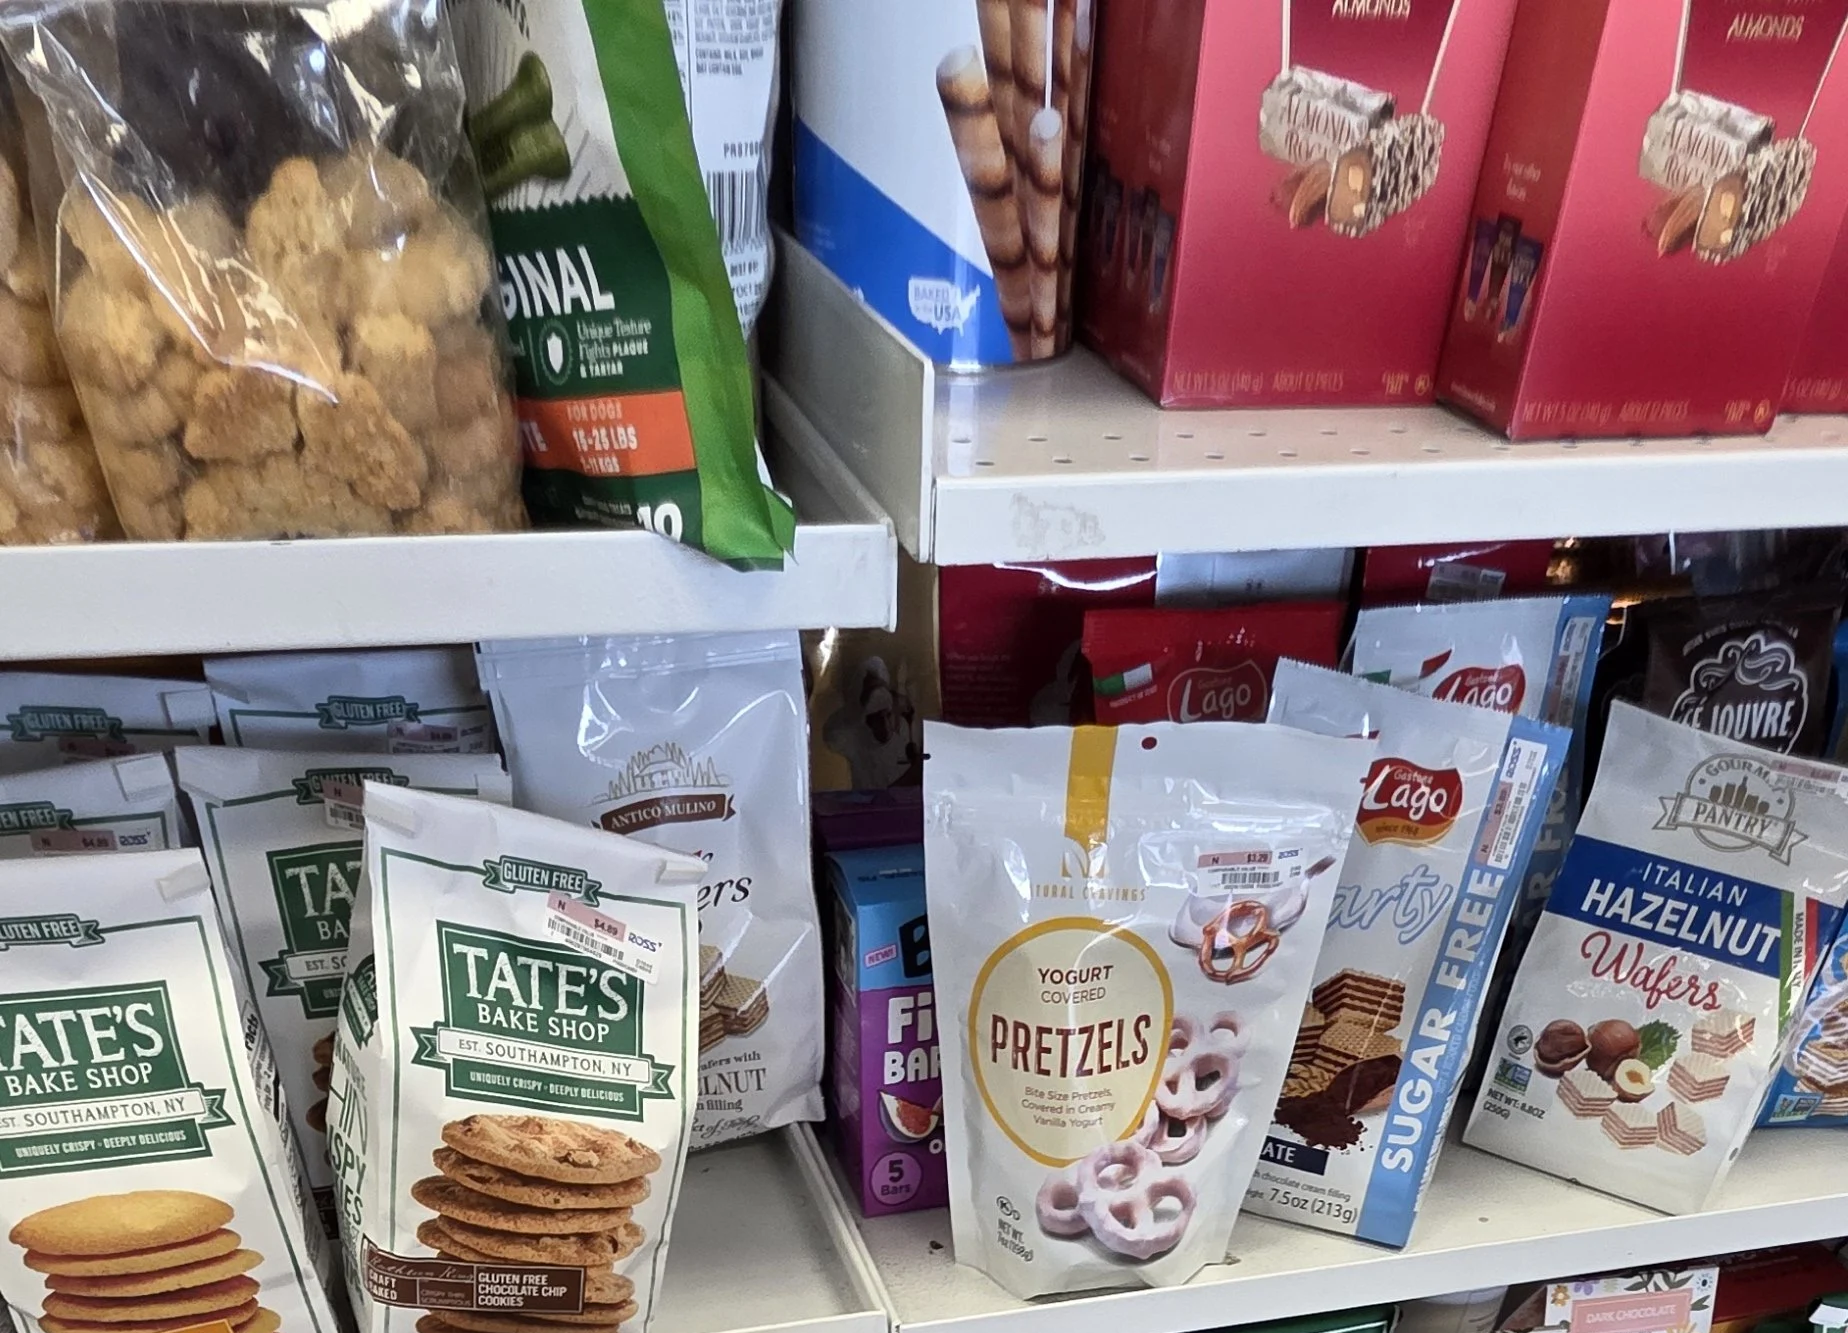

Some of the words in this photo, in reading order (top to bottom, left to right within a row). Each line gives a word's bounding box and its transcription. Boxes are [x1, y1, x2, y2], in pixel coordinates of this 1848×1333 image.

[1726, 13, 1805, 42] ALMONDS
[499, 244, 615, 321] GINAL
[934, 303, 961, 321] USA
[577, 319, 613, 340] Unique
[614, 316, 652, 338] Texture
[567, 401, 588, 421] FOR
[590, 399, 623, 420] DOGS
[572, 428, 610, 452] 15-25
[611, 424, 638, 450] LBS
[335, 703, 374, 719] GLUTEN
[376, 702, 404, 718] FREE
[1180, 678, 1251, 723] Lago
[29, 712, 73, 730] GLUTEN
[75, 714, 106, 731] FREE
[1362, 764, 1448, 821] Lago
[22, 808, 55, 827] FREE
[611, 804, 662, 831] ANTICO
[662, 799, 717, 819] MULINO
[1692, 800, 1771, 840] PANTRY
[503, 862, 550, 886] GLUTEN
[552, 872, 583, 891] FREE
[1642, 861, 1748, 907] ITALIAN
[697, 876, 752, 911] ers
[1082, 886, 1146, 901] CAVINGS
[1327, 863, 1453, 945] arty
[42, 919, 80, 939] FREE
[316, 919, 350, 941] BA
[557, 900, 567, 911] N
[628, 931, 657, 953] ROSS
[1581, 878, 1782, 964] HAZELNUT
[453, 942, 629, 1022] TATE'S
[1038, 965, 1114, 985] YOGURT
[1580, 931, 1722, 1010] Wafers
[1041, 986, 1107, 1004] COVERED
[477, 1003, 539, 1033] BAKE
[548, 1017, 611, 1043] SHOP
[1381, 1005, 1456, 1174] SUGAR
[1436, 868, 1505, 992] FREE
[458, 1038, 482, 1052] EST.
[486, 1042, 606, 1074] SOUTHAMPTON,
[612, 1061, 632, 1077] NY
[733, 1051, 761, 1064] with
[992, 1014, 1151, 1078] PRETZELS
[5, 1070, 79, 1097] BAKE
[87, 1062, 153, 1089] SHOP
[470, 1071, 510, 1087] UNIQUELY
[513, 1077, 542, 1093] CRISPY
[549, 1083, 579, 1098] DEEPLY
[580, 1088, 625, 1102] DELICIOUS
[706, 1098, 743, 1112] filling
[1025, 1086, 1046, 1100] Bite
[1048, 1089, 1070, 1101] Size
[1487, 1088, 1503, 1102] NET
[24, 1101, 161, 1128] SOUTHAMPTON,
[164, 1097, 187, 1114] NY
[1021, 1099, 1063, 1115] Covered
[1066, 1102, 1076, 1115] in
[1078, 1101, 1116, 1116] Creamy
[1033, 1114, 1067, 1128] Vanilla
[1070, 1115, 1104, 1129] Yogurt
[15, 1143, 60, 1158] UNIQUELY
[62, 1140, 96, 1154] CRISPY
[104, 1135, 137, 1149] DEEPLY
[139, 1130, 187, 1145] DELICIOUS
[888, 1159, 903, 1183] 5
[880, 1184, 912, 1197] Bars
[1269, 1188, 1309, 1210] 7.5oz
[1311, 1198, 1358, 1224] (213g)
[368, 1269, 397, 1289] CRAFT
[478, 1272, 521, 1286] GLUTEN
[522, 1273, 548, 1286] FREE
[478, 1284, 539, 1297] CHOCOLATE
[541, 1286, 568, 1298] CHIP
[478, 1296, 525, 1308] COOKIES
[1586, 1311, 1615, 1324] DARK
[1615, 1305, 1677, 1321] CHOCOLATE
